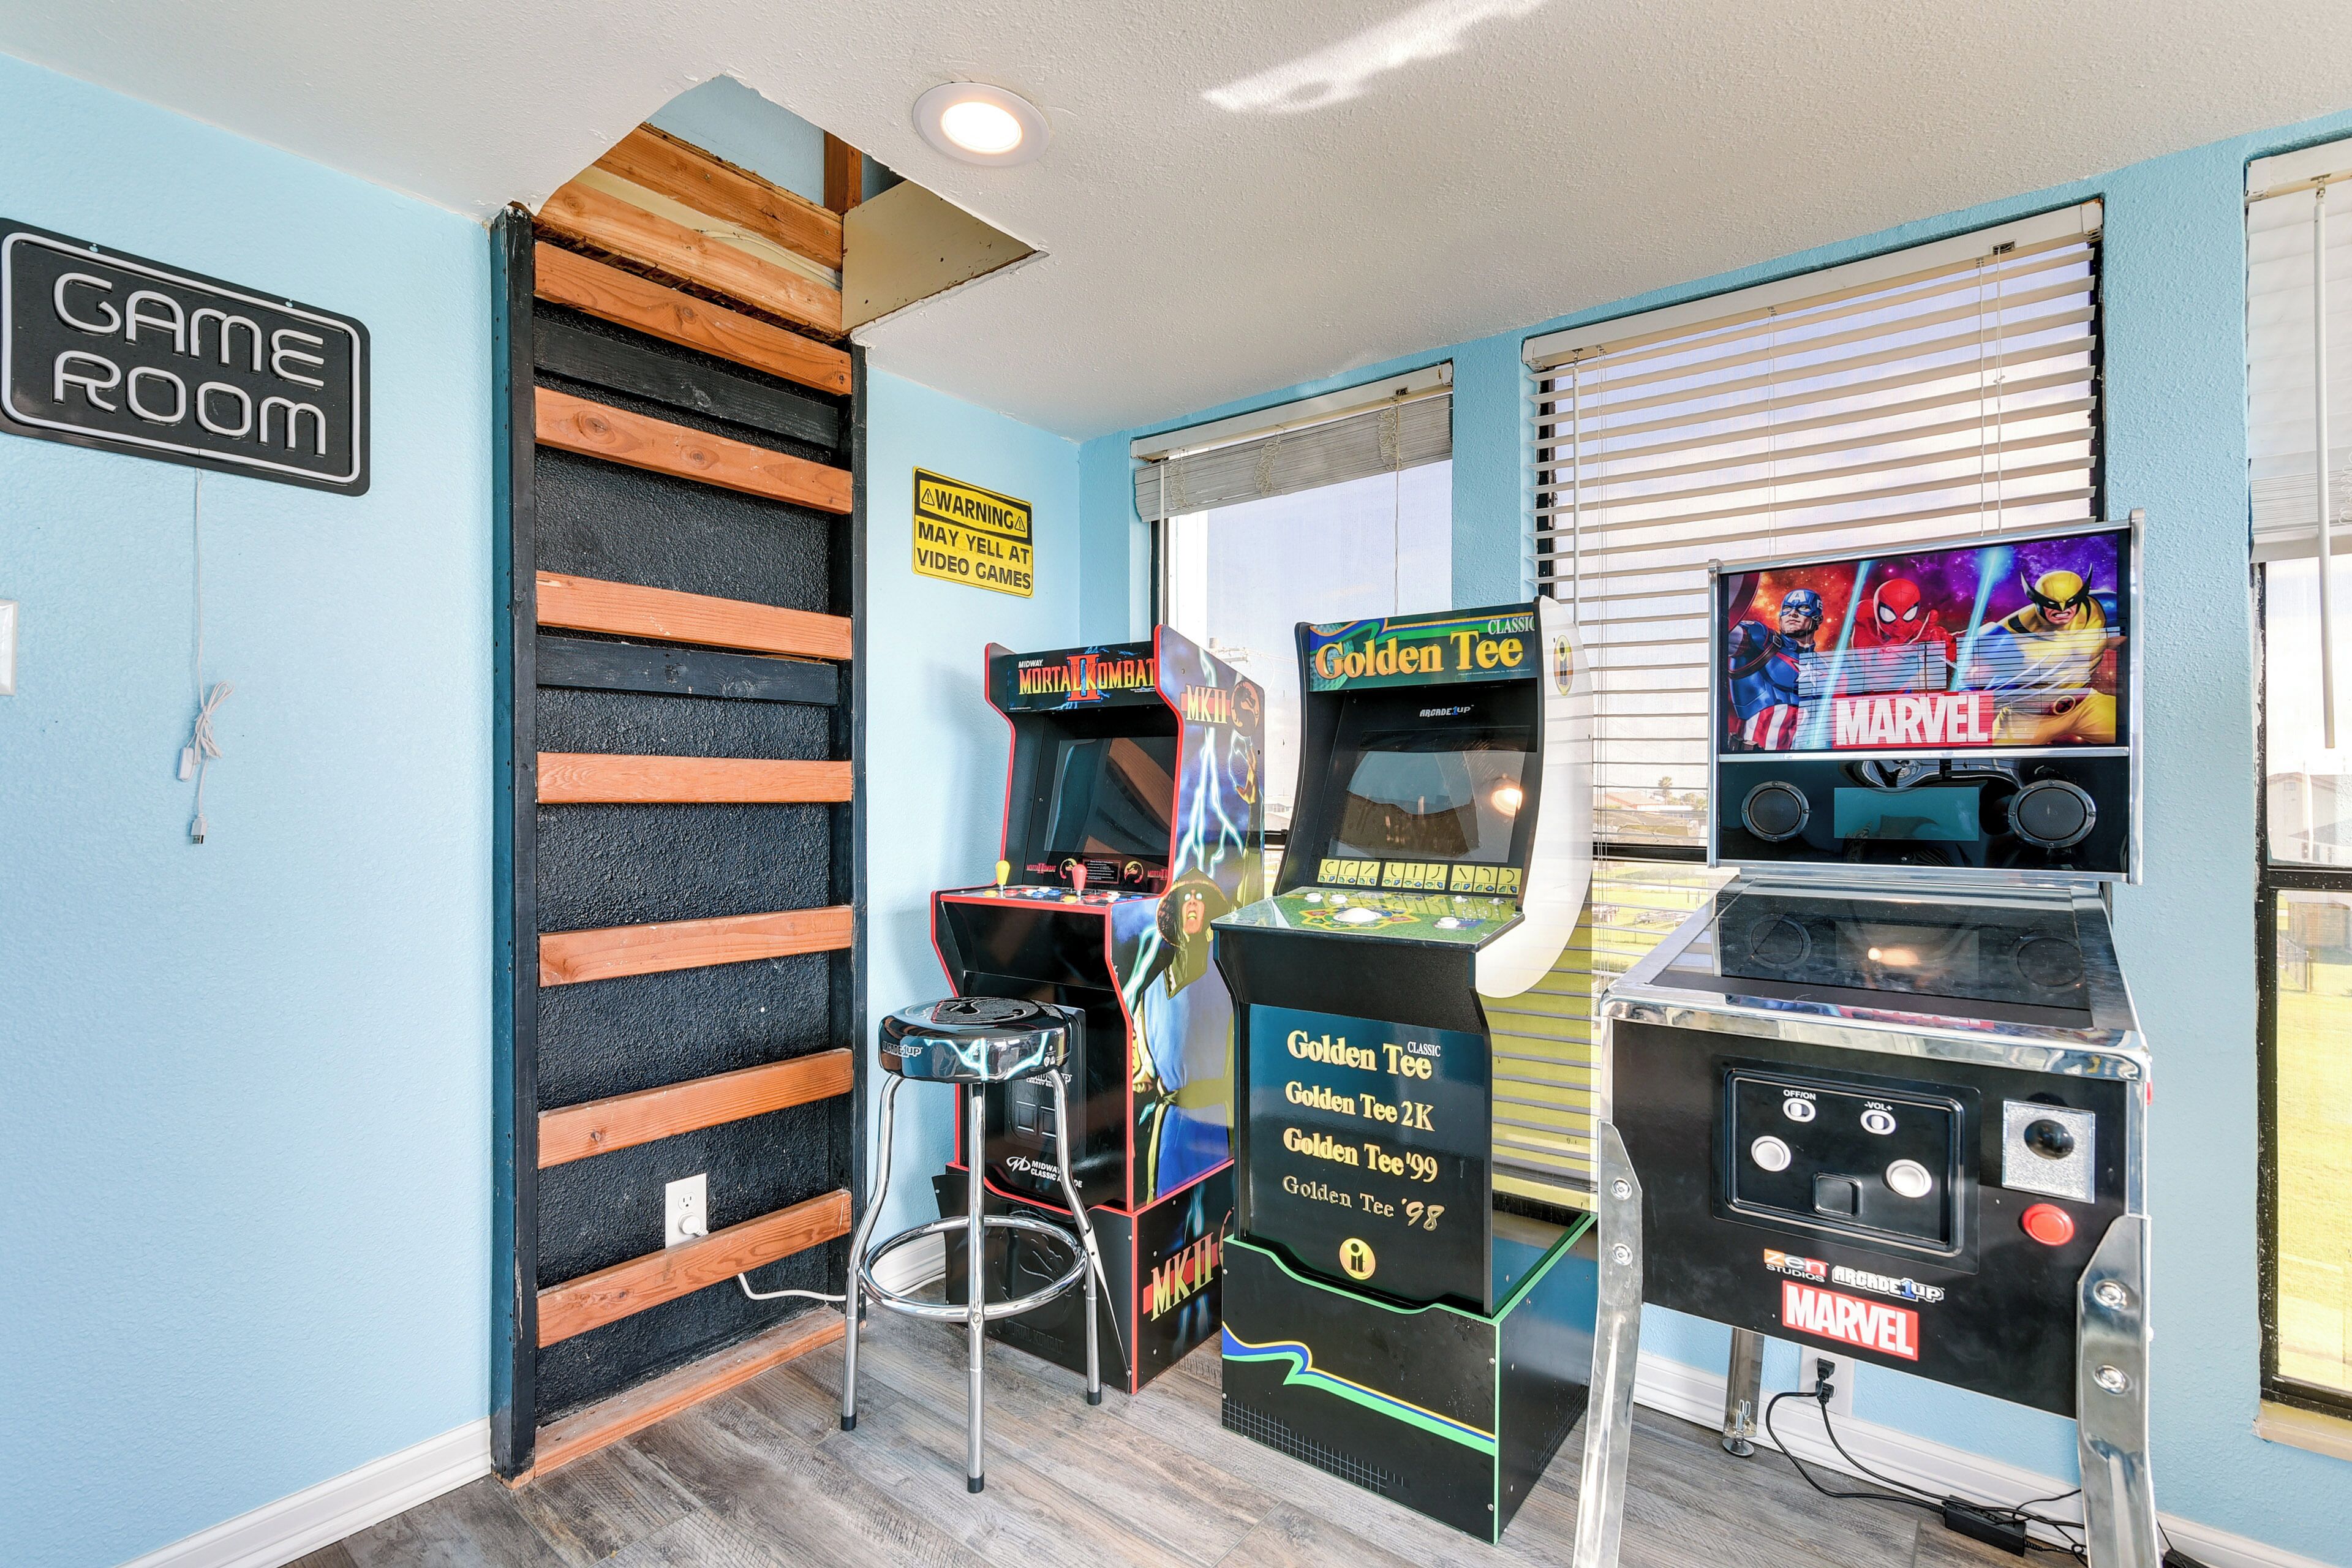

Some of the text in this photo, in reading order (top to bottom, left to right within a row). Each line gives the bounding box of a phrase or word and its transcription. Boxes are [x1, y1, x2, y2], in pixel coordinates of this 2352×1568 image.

[53, 273, 325, 387] GAME
[53, 350, 326, 456] ROOM
[935, 488, 1014, 530] WARNING
[918, 521, 1030, 564] MAY YELL AT
[916, 548, 1031, 589] VIDEO GAMES
[1487, 616, 1536, 635] CLASSIC
[1018, 659, 1044, 669] MIDWAY
[1315, 630, 1523, 680] Golden Tee
[1019, 658, 1155, 695] MORTAL KOMBAT
[1835, 693, 1990, 747] MARVEL
[1287, 1030, 1433, 1080] Golden Tee
[1408, 1041, 1441, 1057] CLASSIC
[1286, 1080, 1436, 1132] Golden Tee 2K
[1783, 1089, 1817, 1101] OFF/ON
[1031, 1160, 1061, 1174] MIDWAY
[1283, 1127, 1439, 1183] Golden Tee '99
[1030, 1168, 1083, 1188] CLASSIC ADE
[1283, 1176, 1446, 1231] Golden Tee '98
[1766, 1264, 1825, 1283] STUDIOS
[1786, 1284, 1914, 1357] MARVEL
